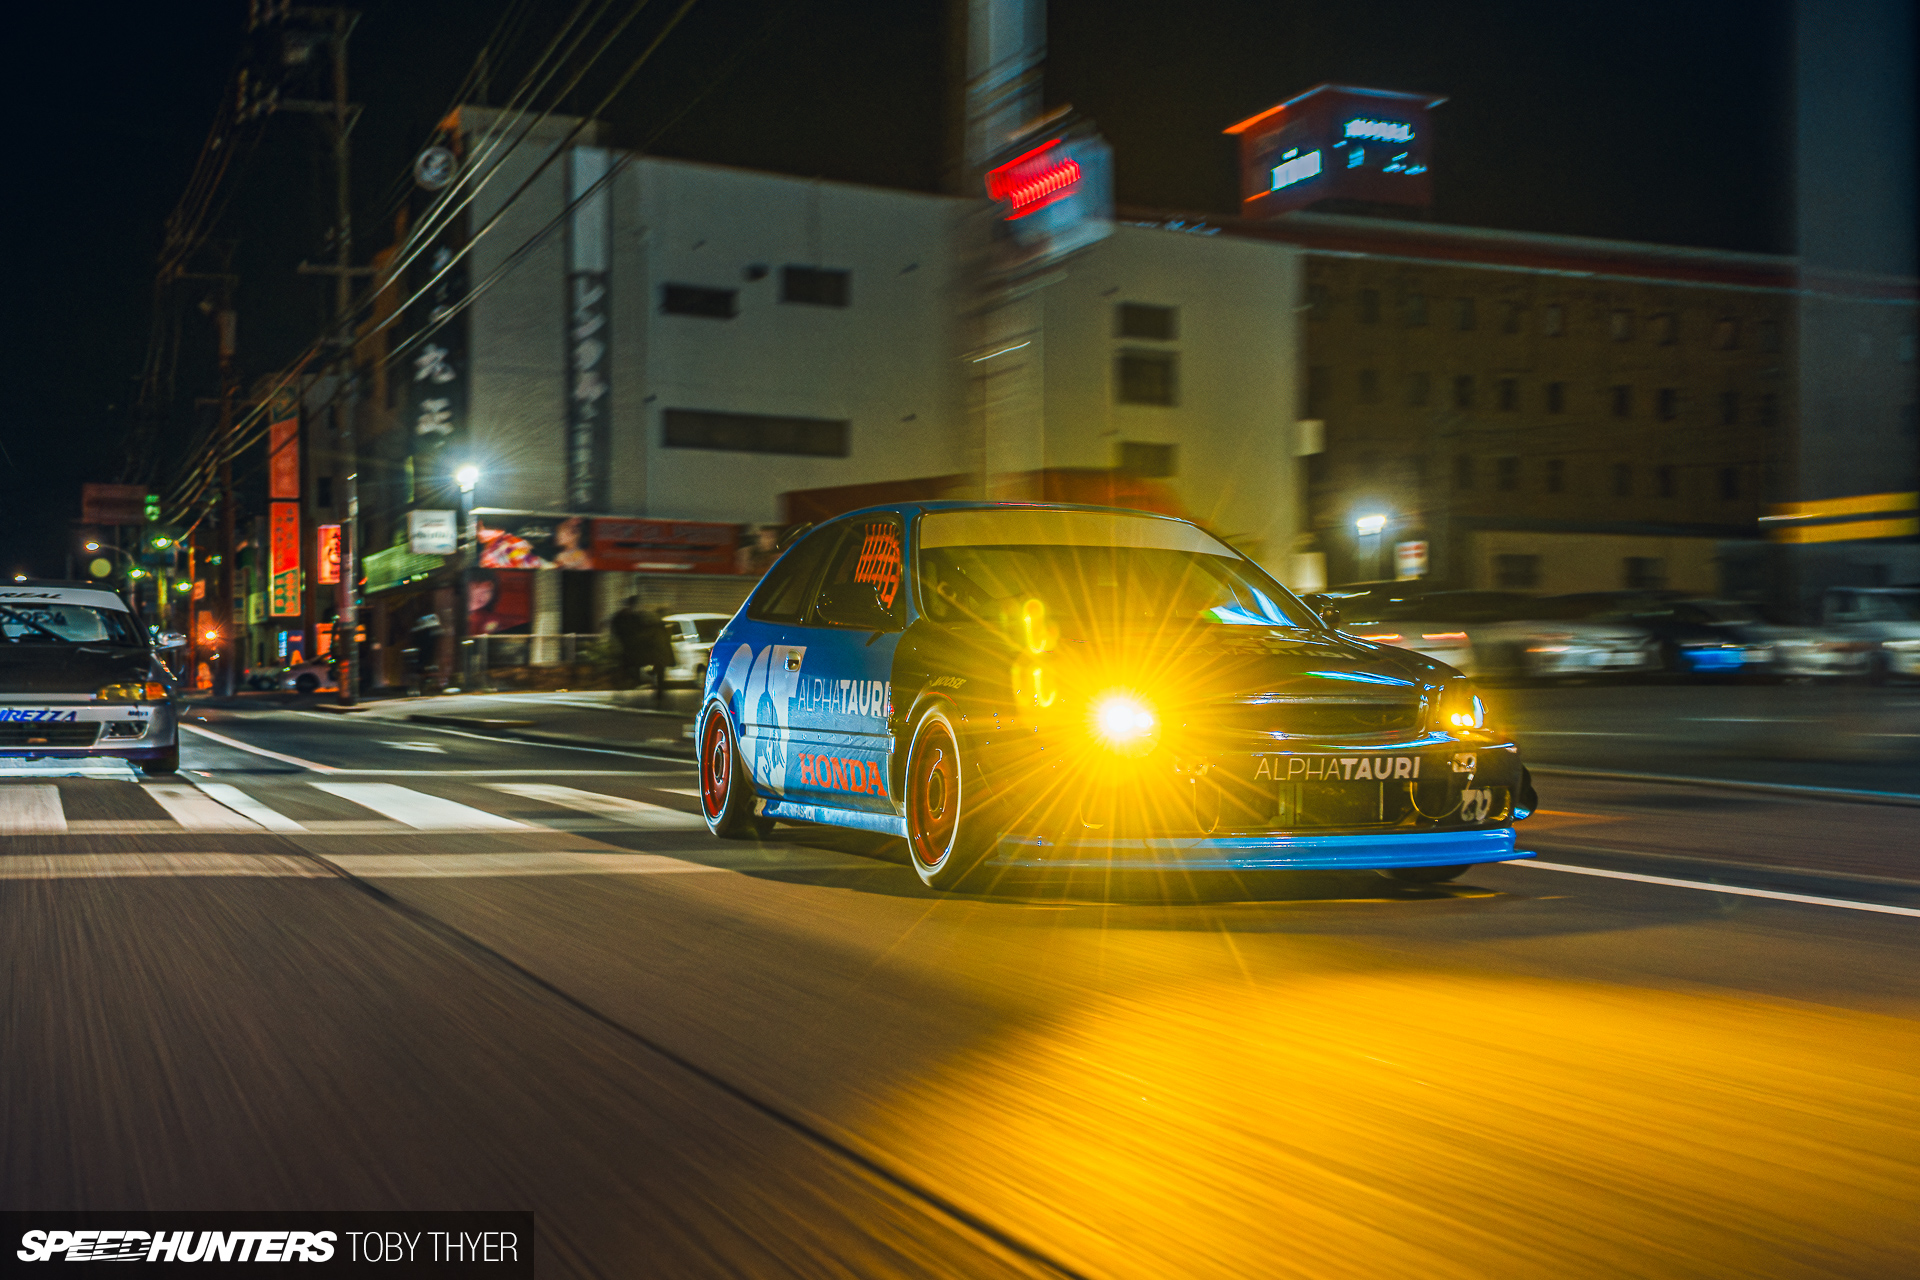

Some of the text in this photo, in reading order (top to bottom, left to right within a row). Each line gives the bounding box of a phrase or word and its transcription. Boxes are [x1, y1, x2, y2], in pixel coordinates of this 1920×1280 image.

[798, 679, 890, 718] ALPHATAURI
[798, 753, 887, 796] HONDA
[1254, 757, 1420, 780] ALPHATAURI
